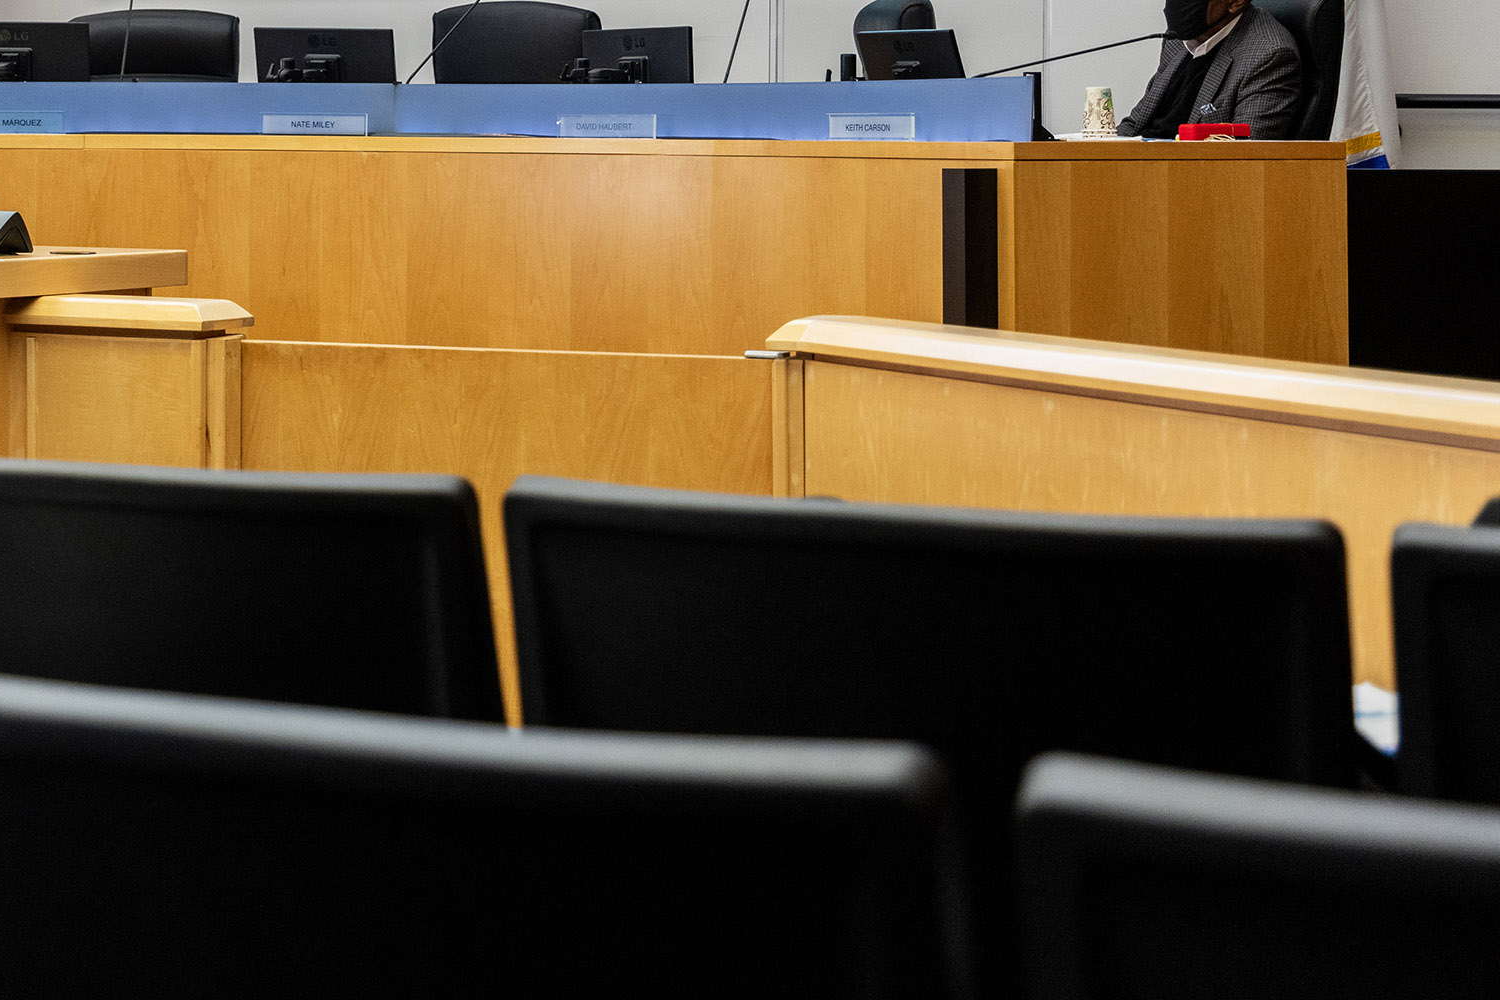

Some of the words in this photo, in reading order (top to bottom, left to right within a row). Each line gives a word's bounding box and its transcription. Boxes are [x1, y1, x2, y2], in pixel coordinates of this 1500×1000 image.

[13, 31, 29, 41] LG
[322, 37, 338, 47] LG
[634, 37, 646, 48] LG
[2, 117, 42, 127] MÁRQUEZ
[312, 121, 336, 129] MILEY
[575, 122, 597, 131] DAVID
[598, 122, 633, 131] HAUBERT
[845, 123, 863, 132] KEITH
[864, 123, 891, 132] CARSON
